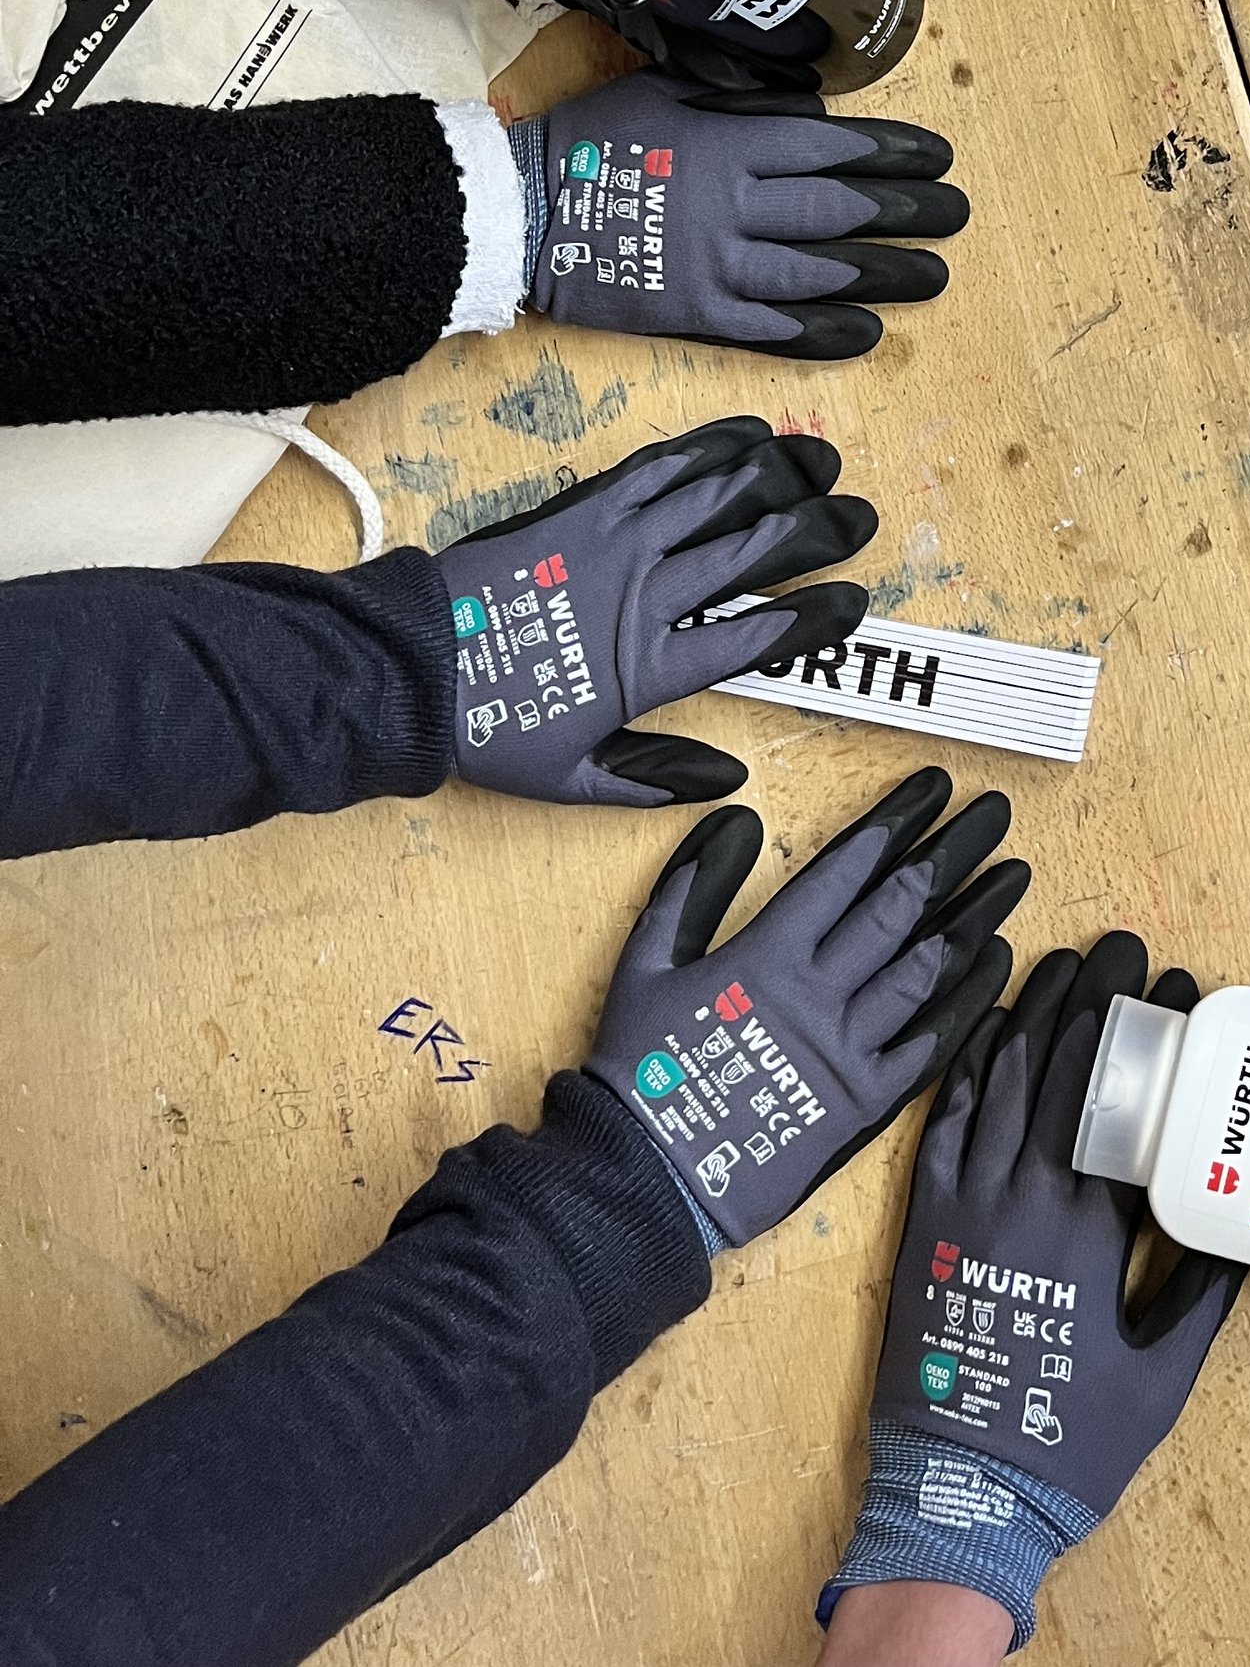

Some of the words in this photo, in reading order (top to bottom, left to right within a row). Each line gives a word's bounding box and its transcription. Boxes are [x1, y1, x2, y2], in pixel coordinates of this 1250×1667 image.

[580, 181, 593, 231] STANDARD
[642, 184, 666, 291] WÜRTH
[477, 632, 498, 684] STANDARD
[546, 589, 597, 706] WÜRTH
[678, 1051, 701, 1078] 0899
[697, 1078, 716, 1099] 405
[710, 1095, 730, 1118] 218
[739, 1016, 827, 1126] WÜRTH
[677, 1083, 716, 1131] STANDARD
[962, 1257, 1076, 1310] WÜRTH
[940, 1337, 964, 1353] 0899
[965, 1345, 986, 1360] 405
[987, 1351, 1009, 1366] 218
[958, 1364, 1010, 1387] STANDARD
